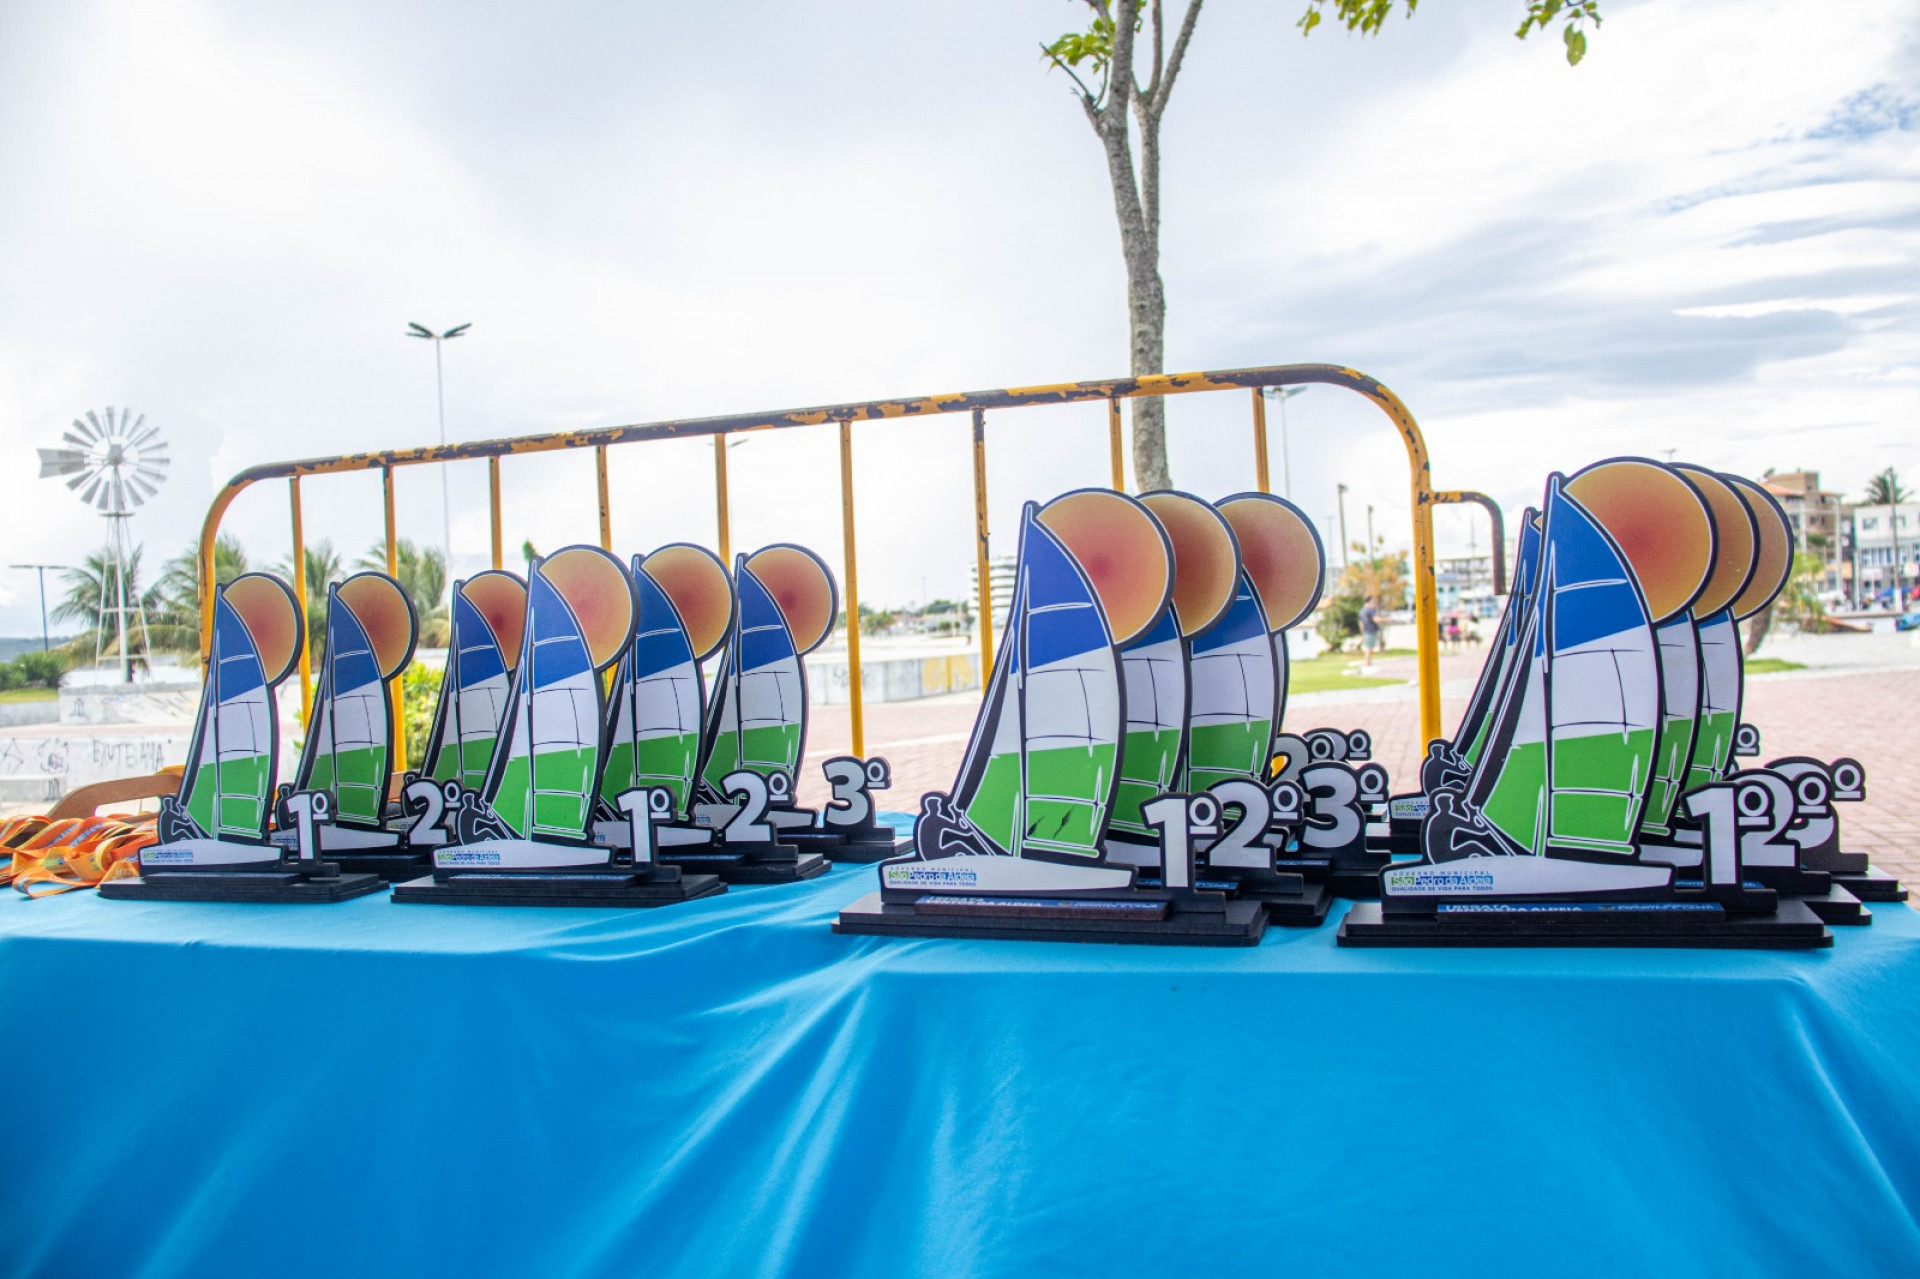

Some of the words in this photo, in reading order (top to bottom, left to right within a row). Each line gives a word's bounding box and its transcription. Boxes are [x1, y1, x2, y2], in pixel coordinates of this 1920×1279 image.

[287, 792, 329, 860] 1º
[406, 781, 461, 845] 2º
[617, 787, 670, 863] 1º
[723, 772, 788, 842] 2º
[826, 760, 885, 826] 3º
[1209, 781, 1298, 868] 2º
[1303, 767, 1384, 849] 3º
[1730, 774, 1827, 867] 2º
[1144, 797, 1217, 888] 1º
[1686, 785, 1770, 885] 1º
[889, 871, 908, 879] São
[1392, 876, 1414, 885] São
[1416, 876, 1444, 885] Pedro
[1461, 876, 1492, 884] Aldeia
